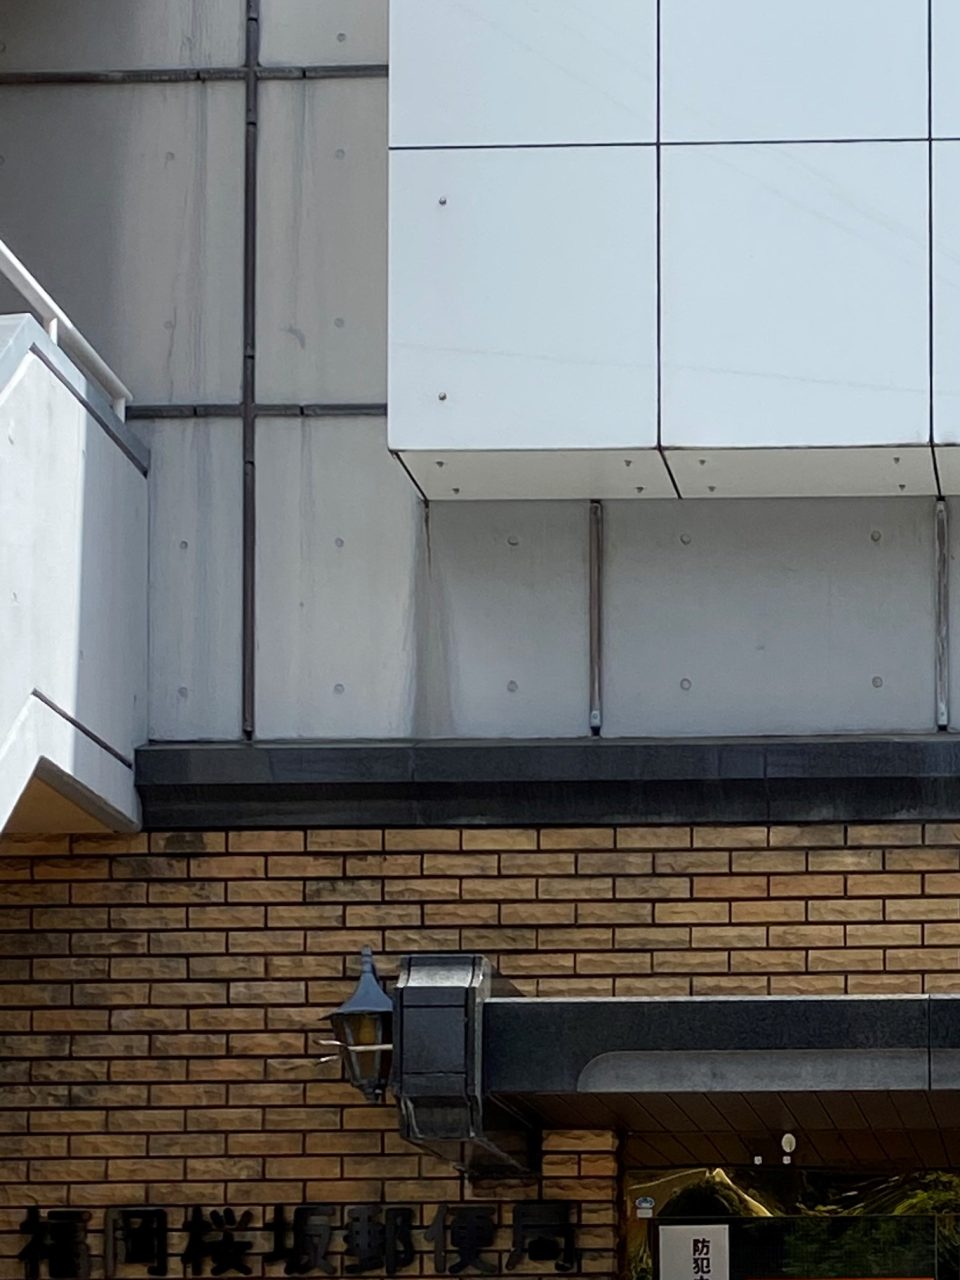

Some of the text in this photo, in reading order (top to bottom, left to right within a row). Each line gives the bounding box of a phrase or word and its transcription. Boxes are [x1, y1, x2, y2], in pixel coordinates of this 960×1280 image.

[18, 1205, 580, 1280] 福岡桜坂郵便局
